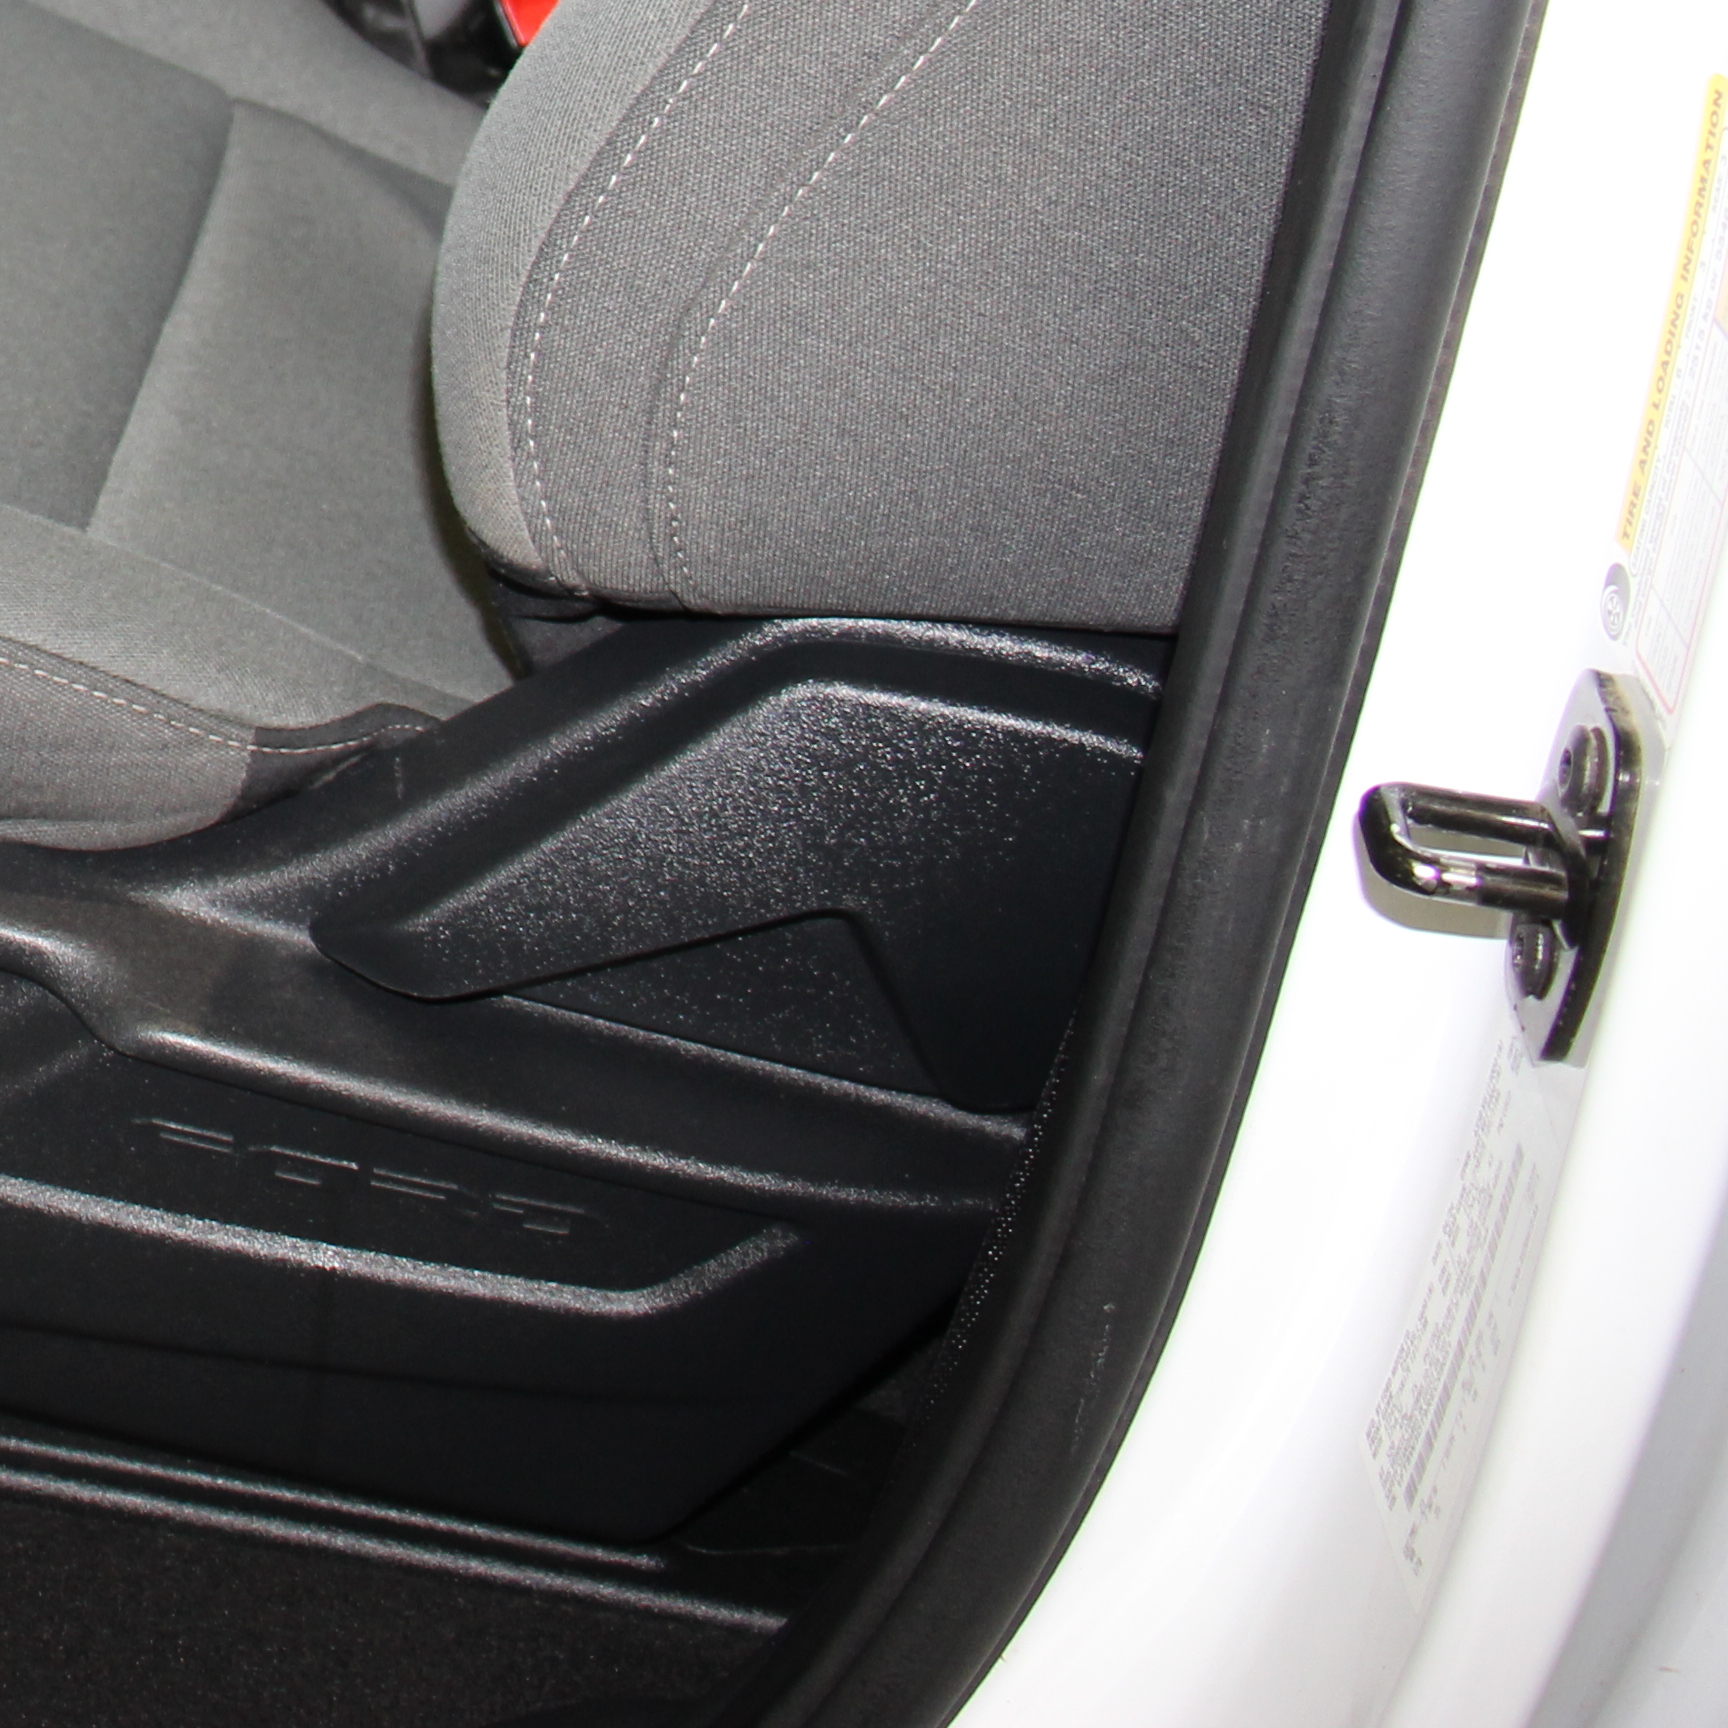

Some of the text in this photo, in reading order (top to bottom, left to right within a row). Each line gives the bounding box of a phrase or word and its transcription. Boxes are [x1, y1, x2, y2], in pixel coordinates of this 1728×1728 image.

[1621, 480, 1643, 542] TIRE
[1637, 418, 1656, 477] AND
[1651, 291, 1686, 411] LOADING
[1680, 87, 1725, 283] INFORMATION
